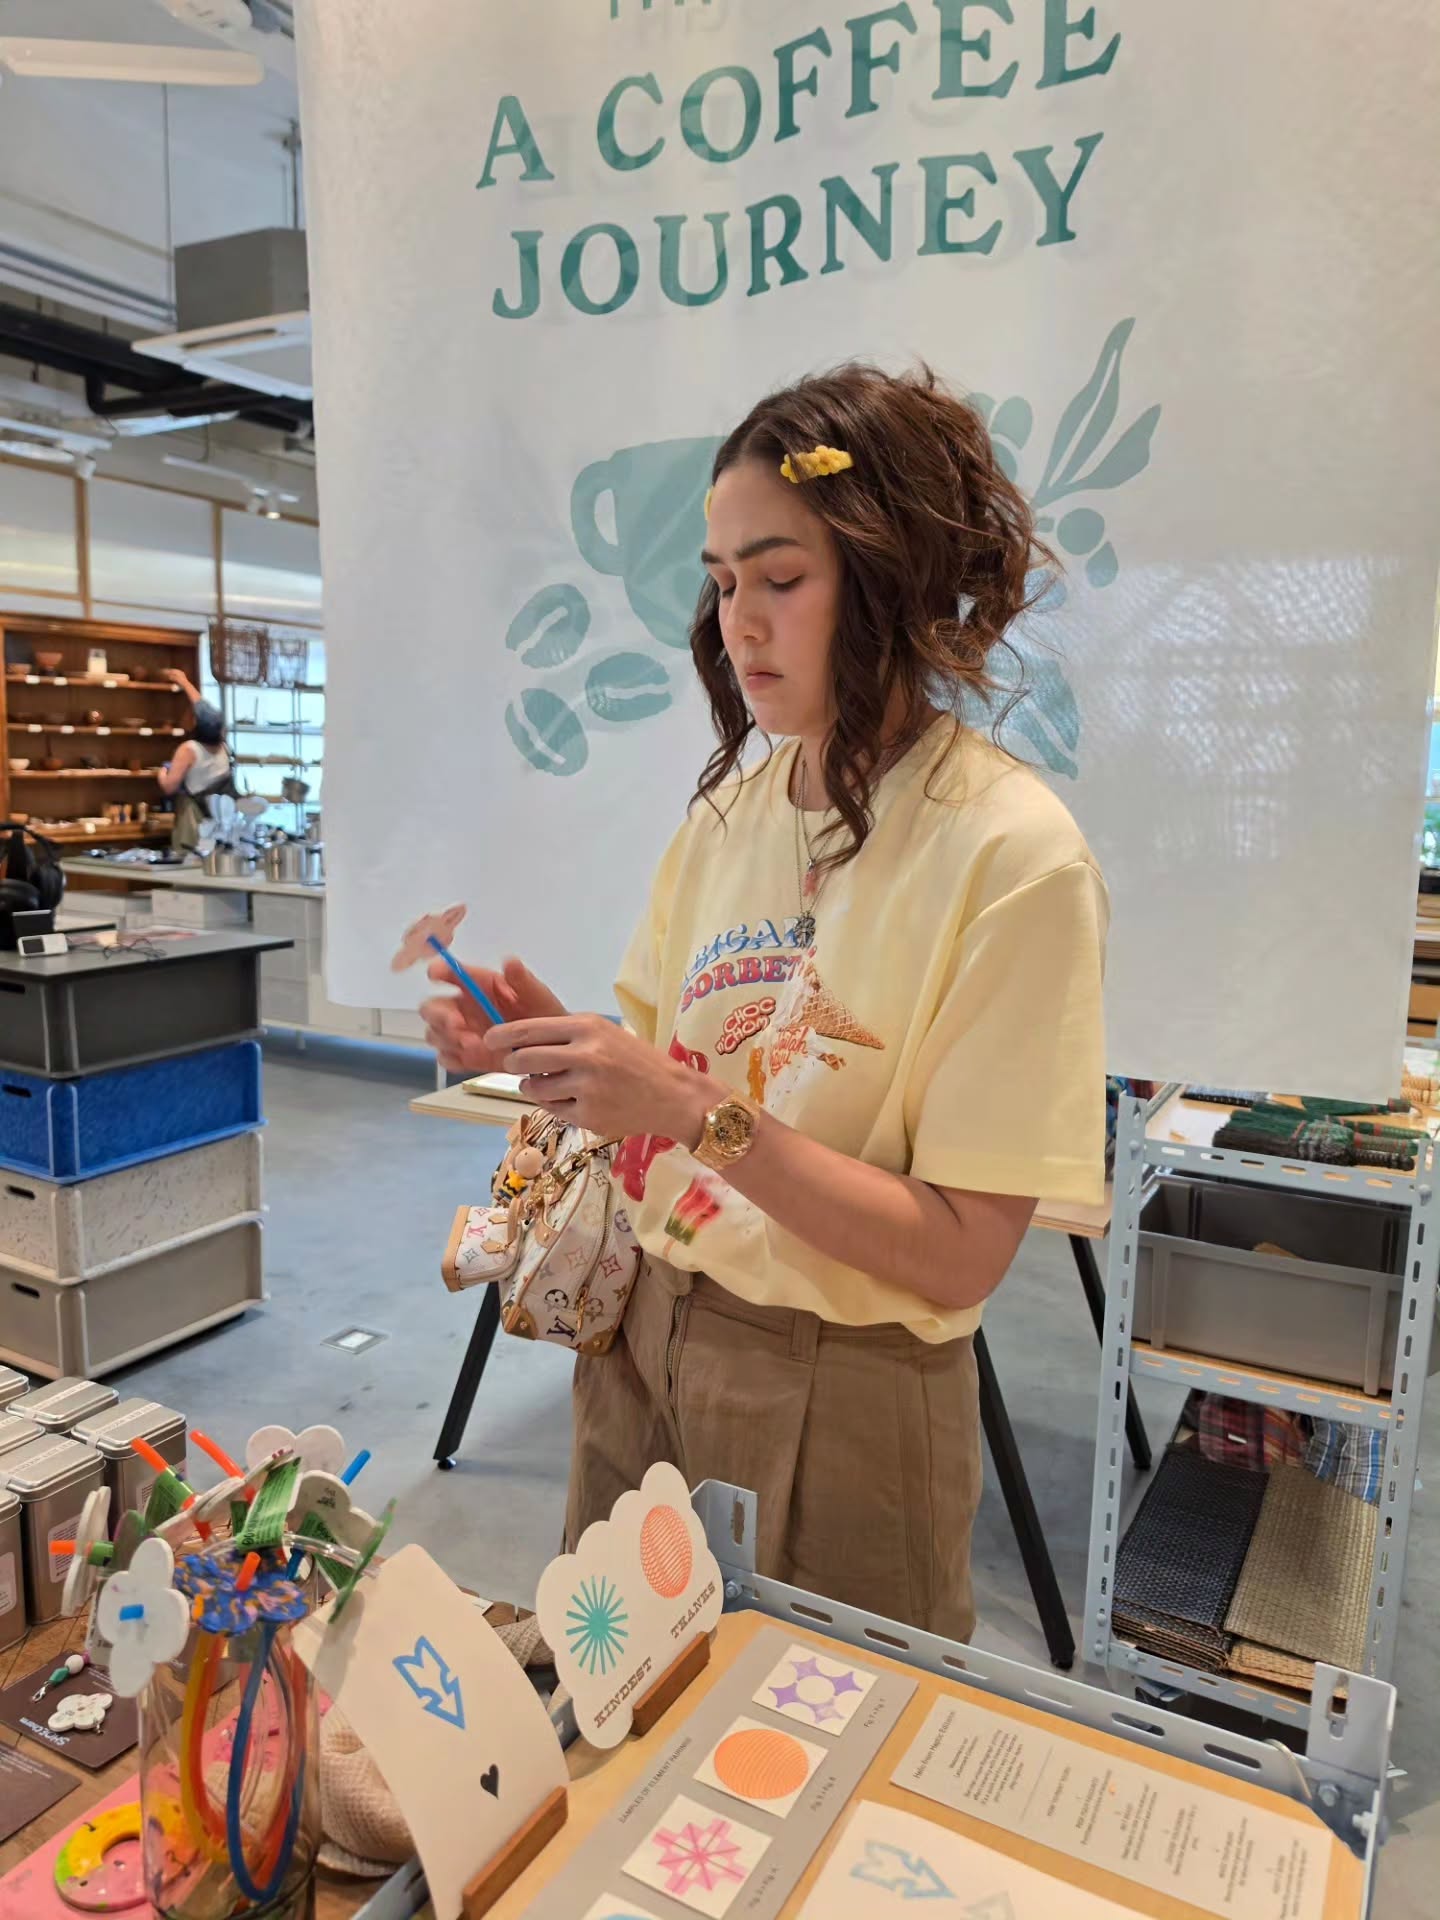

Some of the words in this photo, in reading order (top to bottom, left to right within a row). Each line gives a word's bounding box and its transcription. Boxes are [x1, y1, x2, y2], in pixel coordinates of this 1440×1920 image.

[475, 94, 555, 189] A
[596, 0, 1121, 172] COFFEE
[492, 132, 1104, 319] JOURNEY
[724, 998, 775, 1033] CHOC
[593, 1656, 652, 1729] KINDEST
[669, 1581, 717, 1639] THANKS
